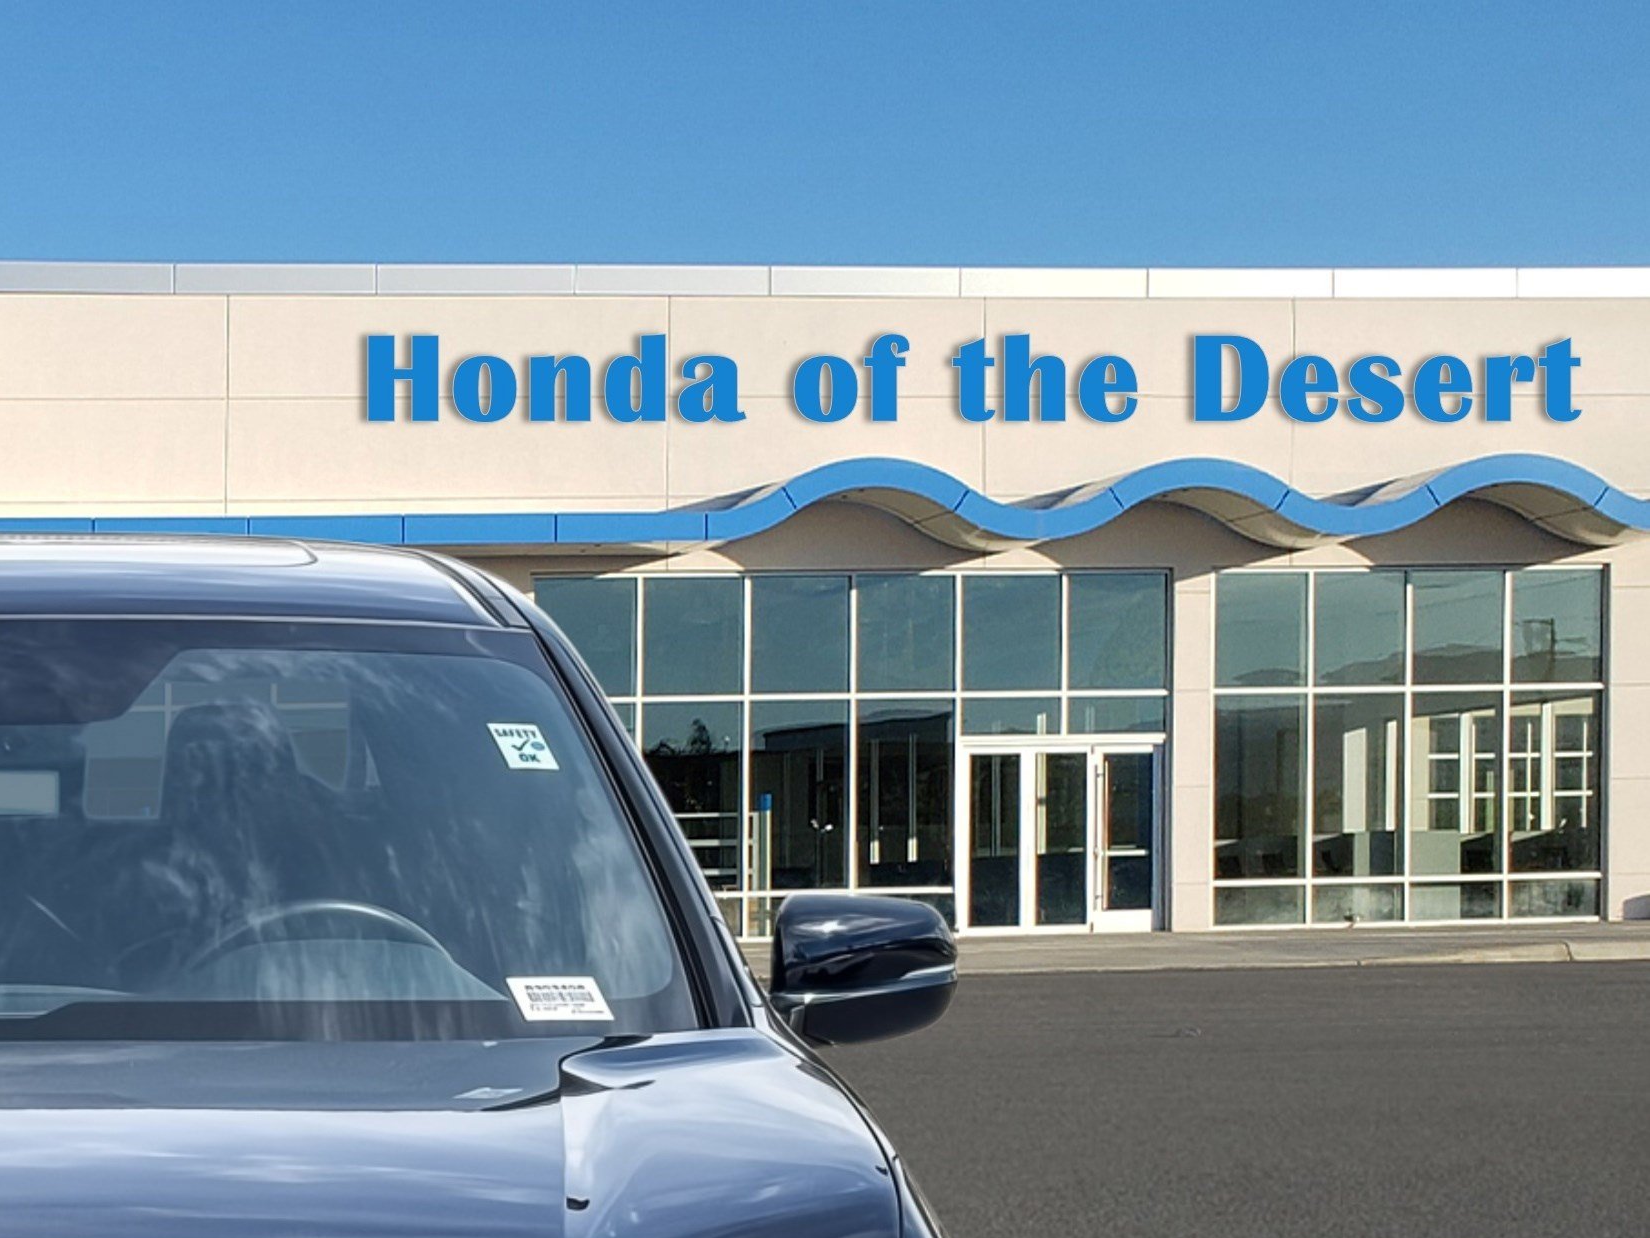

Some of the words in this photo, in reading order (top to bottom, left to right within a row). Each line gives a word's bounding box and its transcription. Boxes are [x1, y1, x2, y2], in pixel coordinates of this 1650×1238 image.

[365, 333, 747, 423] Honda
[793, 333, 910, 423] of
[951, 333, 1138, 423] the
[1193, 335, 1583, 423] Desert
